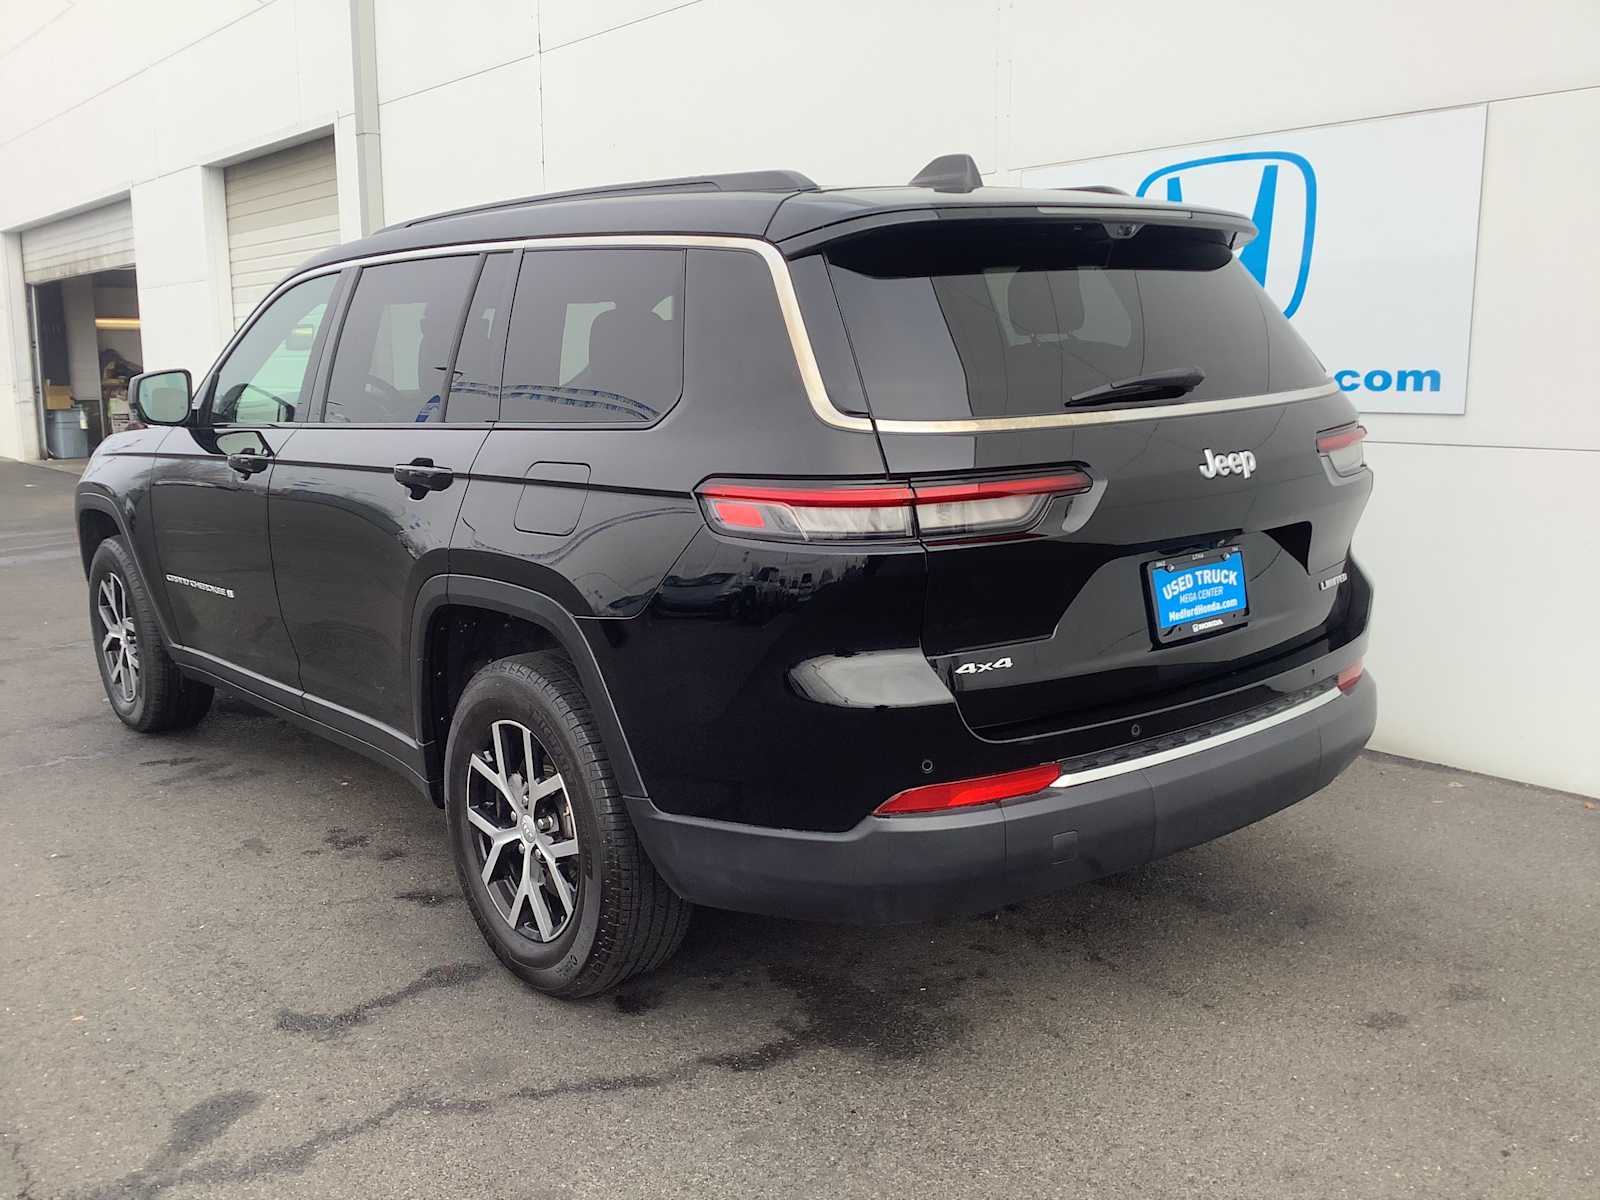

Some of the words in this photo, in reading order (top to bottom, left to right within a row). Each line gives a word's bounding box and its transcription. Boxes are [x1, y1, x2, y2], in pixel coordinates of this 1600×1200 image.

[1199, 448, 1256, 479] Jeep
[1162, 573, 1194, 600] USED
[1195, 568, 1238, 586] TRUCK
[1179, 591, 1198, 604] MEGA
[1198, 586, 1224, 600] CENTER
[1168, 598, 1238, 622] MedfordHonda.com
[954, 657, 1013, 674] 4x4
